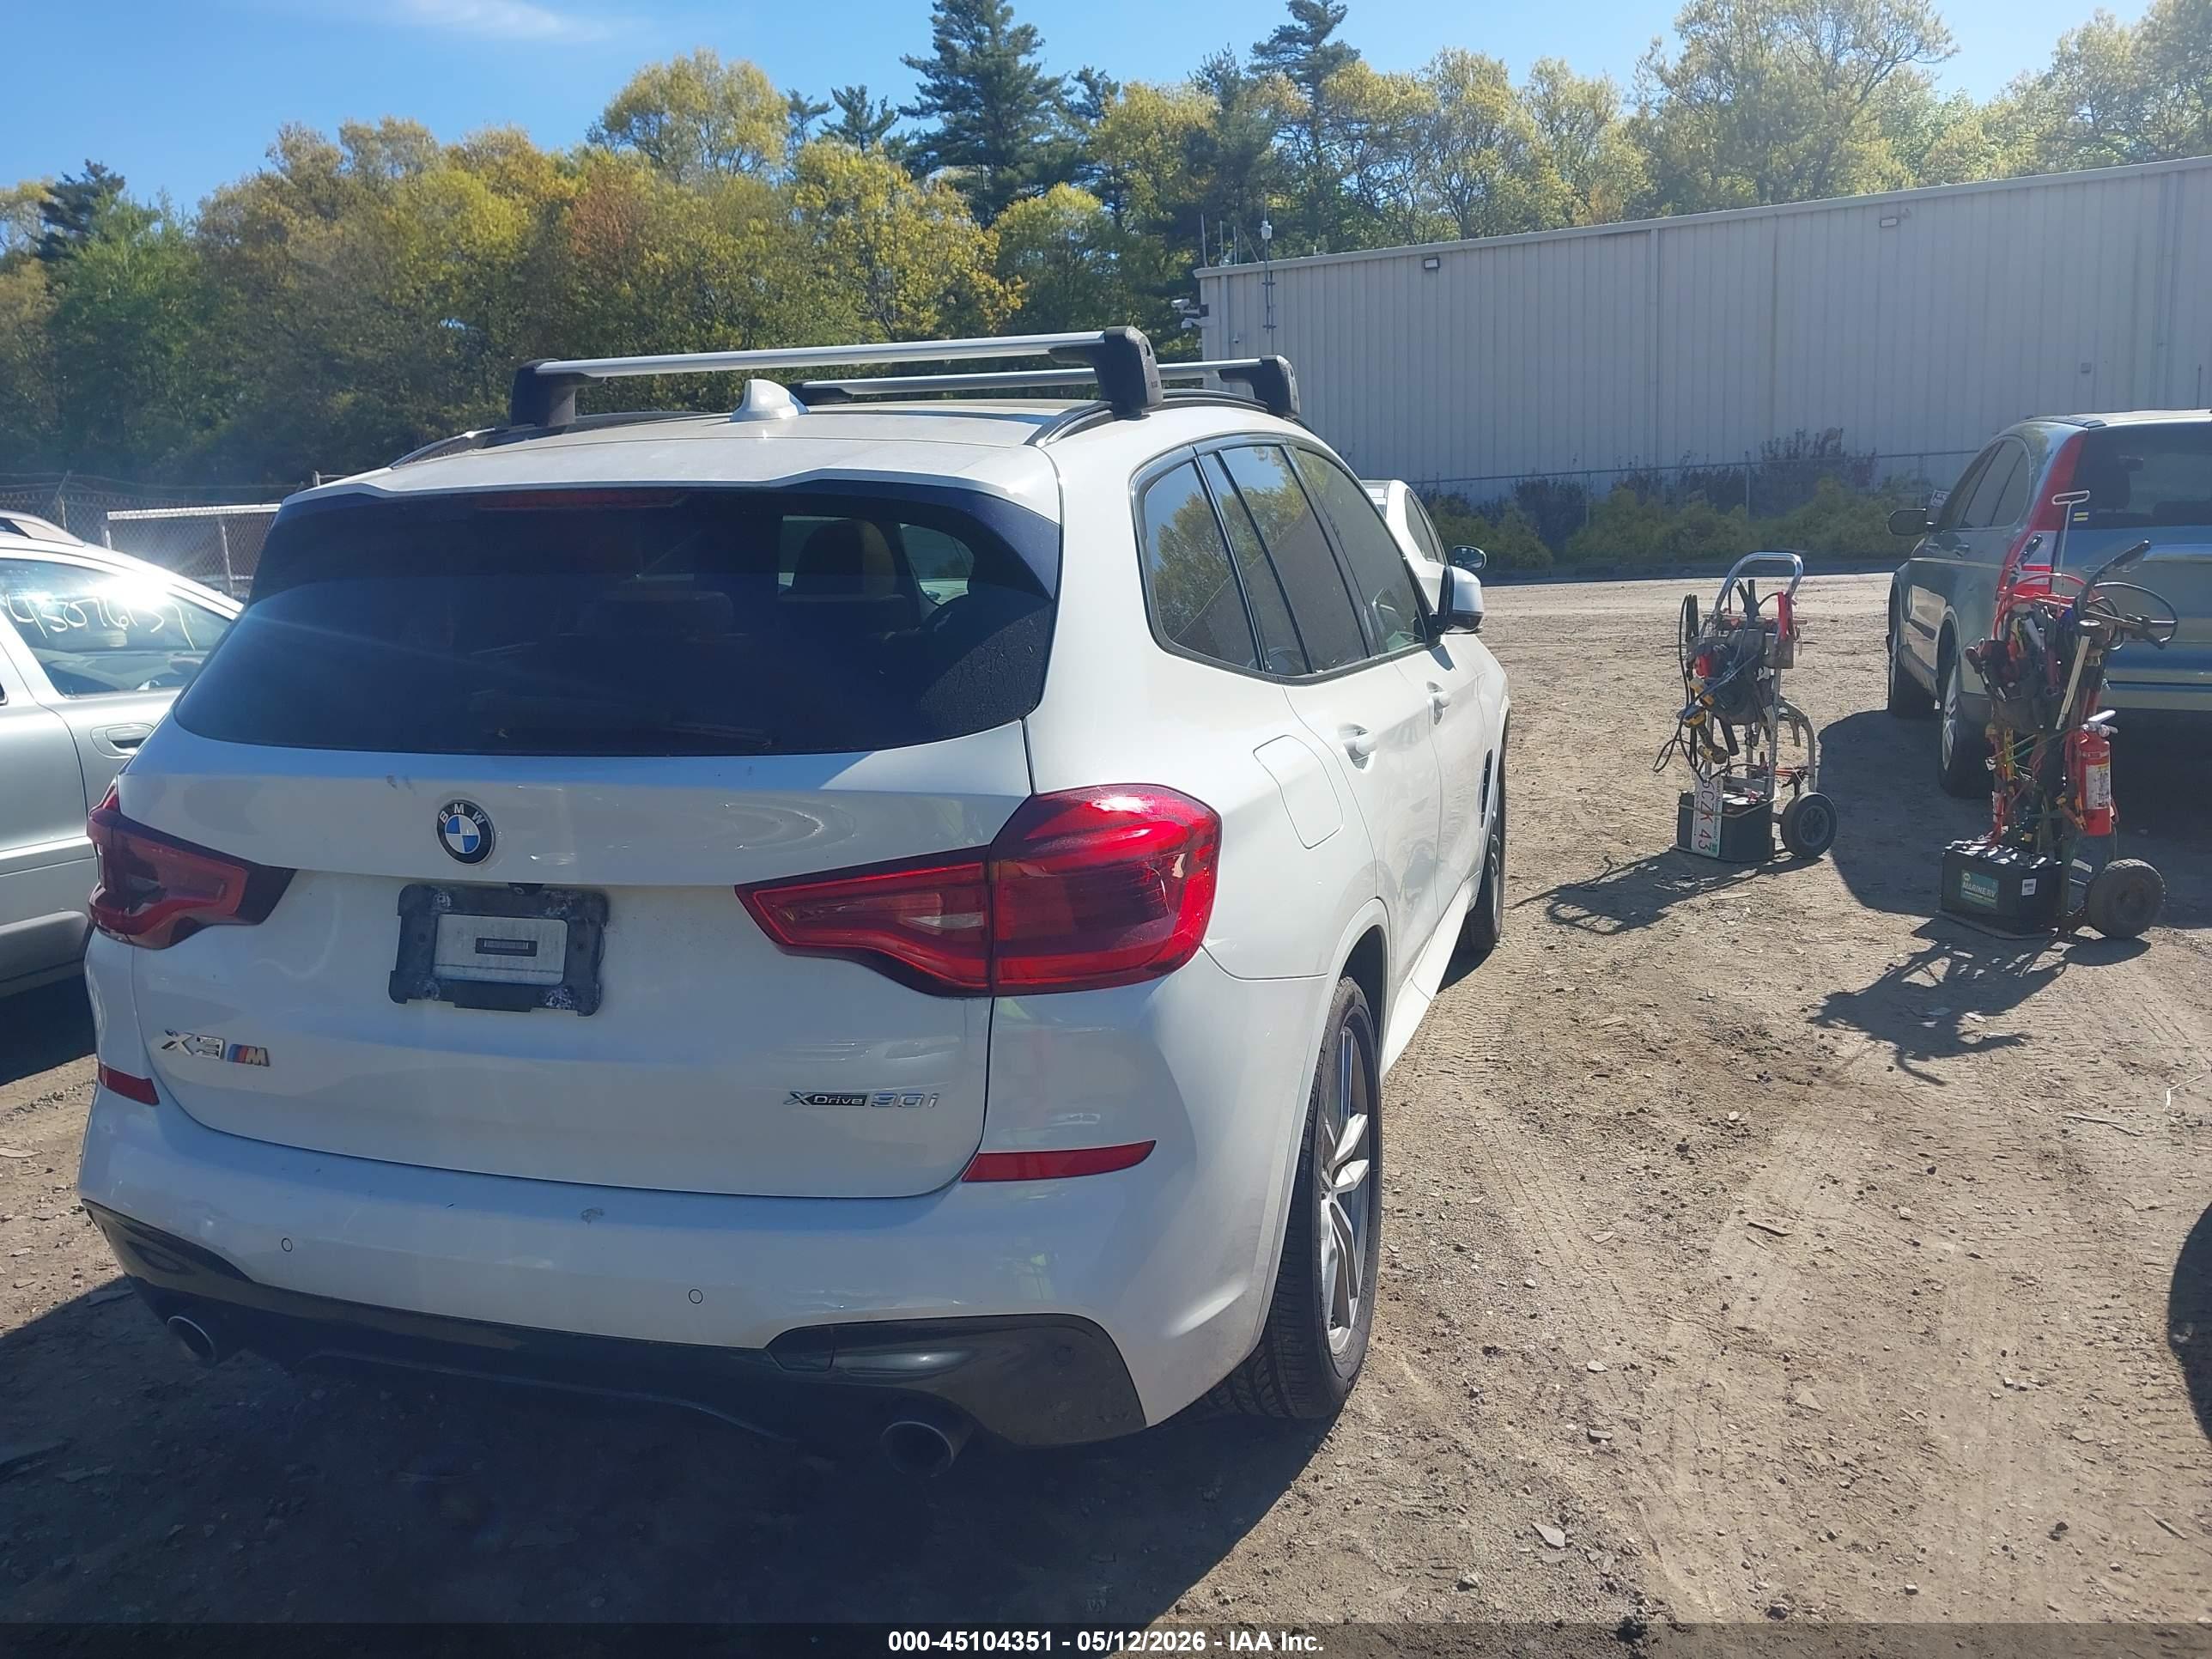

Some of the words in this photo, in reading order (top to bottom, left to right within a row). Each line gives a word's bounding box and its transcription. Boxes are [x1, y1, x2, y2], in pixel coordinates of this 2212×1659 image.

[439, 803, 485, 825] BMW
[1698, 829, 1712, 851] 43
[161, 1030, 225, 1060] X3
[871, 1093, 939, 1108] 30i
